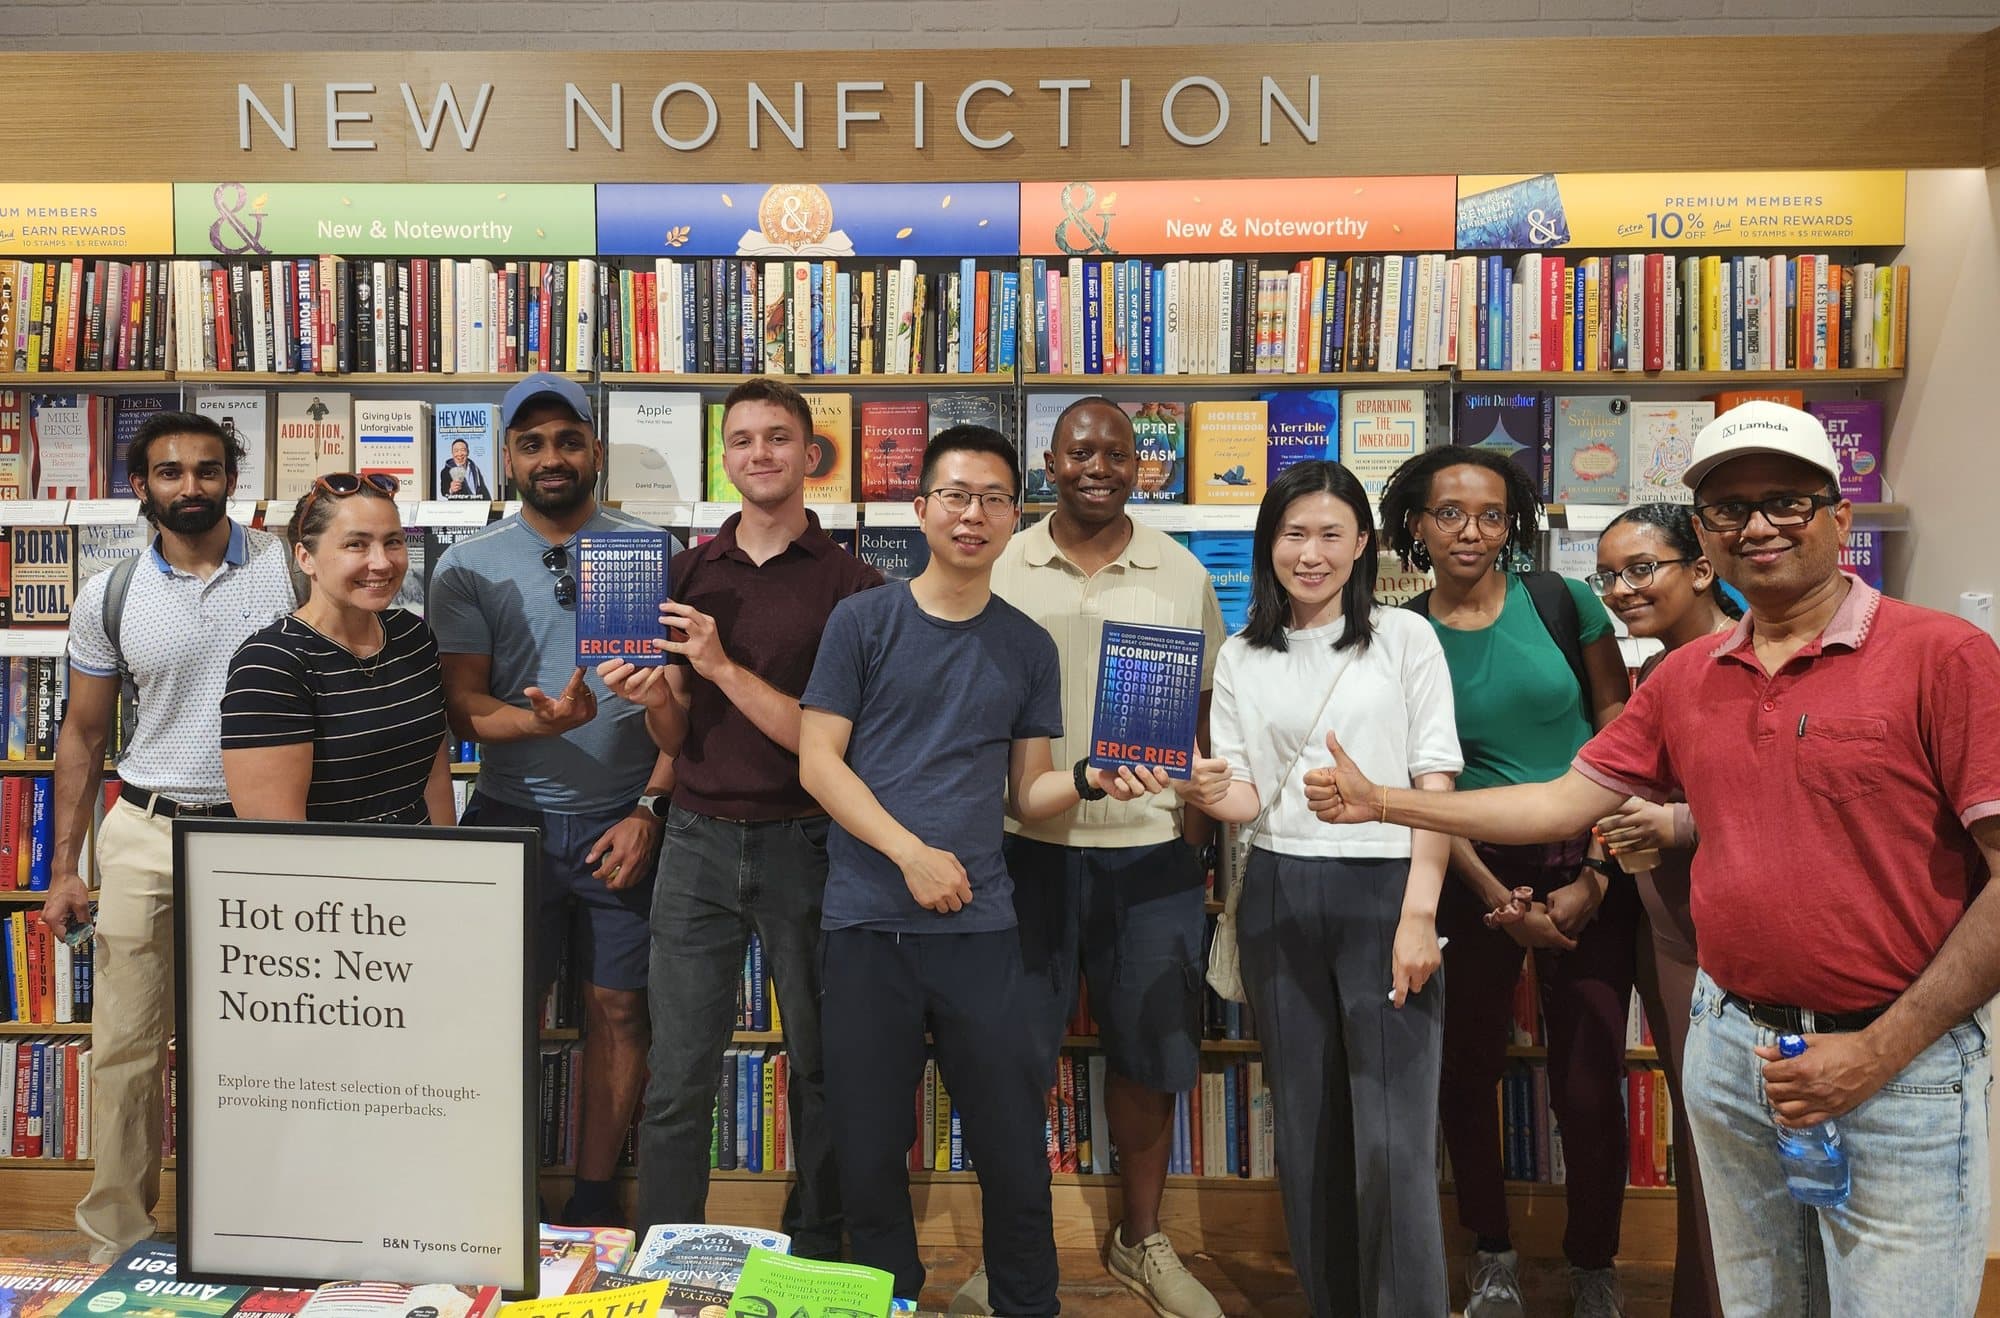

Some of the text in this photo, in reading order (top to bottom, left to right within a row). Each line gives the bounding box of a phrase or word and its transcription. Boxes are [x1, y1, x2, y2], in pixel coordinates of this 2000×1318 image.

[237, 74, 1320, 151] NEW NONFICTION
[1665, 196, 1823, 207] PREMIUM MEMBERS
[27, 208, 97, 217] MEMBERS
[781, 196, 812, 233] &
[1527, 208, 1563, 245] &
[1618, 212, 1704, 240] Extra 10 %
[1740, 215, 1853, 226] EARN REWARDS
[22, 226, 127, 236] EARN REWARDS
[317, 220, 513, 244] New & Noteworthy
[1166, 217, 1368, 241] New & Noteworthy
[1684, 230, 1706, 240] OFF
[232, 266, 244, 292] SCALIA
[299, 270, 311, 344] BLUE POWER
[701, 308, 710, 322] Very
[1131, 310, 1138, 320] OF
[1168, 302, 1178, 333] GODS
[1816, 284, 1829, 350] RESURFACE
[1633, 328, 1641, 350] Point?
[122, 398, 162, 409] The Fix
[1356, 400, 1412, 414] REPARENTING
[1465, 394, 1536, 408] Spirit Daughter
[362, 412, 412, 422] Giving Up Is
[637, 404, 672, 417] Apple
[1207, 412, 1257, 422] HONEST
[47, 412, 80, 423] MIKE
[438, 410, 488, 428] HEY YANG,
[1376, 416, 1392, 430] THE
[1568, 414, 1622, 427] Smallest
[44, 424, 82, 436] PENCE
[282, 424, 345, 441] ADDICTION,
[360, 424, 414, 434] Unforgivable
[865, 424, 922, 436] Firestorm
[1134, 423, 1176, 434] MPIRE
[1201, 423, 1264, 432] MOTHERHOOD
[1270, 422, 1326, 433] A Terrible
[1589, 426, 1616, 439] Joys
[1739, 422, 1789, 433] Lambda
[54, 441, 73, 450] What
[1143, 438, 1156, 447] OF
[1267, 435, 1329, 446] STRENGTH
[1358, 434, 1410, 448] INNER CHILD
[323, 440, 344, 456] Inc.
[866, 478, 921, 486] Jacob Soboroff
[1152, 492, 1176, 500] HUET
[1635, 492, 1666, 502] sarah
[87, 526, 134, 539] We the
[436, 534, 452, 544] THE
[14, 530, 68, 564] BORN
[861, 534, 907, 550] Robert
[81, 544, 140, 560] Women
[581, 550, 663, 561] INCORRUPTIBLE
[581, 561, 663, 571] INCORRUPTIBLE
[861, 554, 908, 570] Wright
[1514, 564, 1530, 572] TO
[581, 572, 662, 582] INCORRUPTIBLE
[14, 584, 70, 619] EQUAL
[1138, 634, 1166, 643] COMPANIES
[580, 640, 662, 654] ERIC RIES
[1106, 644, 1198, 666] INCORRUPTIBLE
[1106, 656, 1196, 678] INCORRUPTIBLE
[1104, 668, 1196, 689] INCORRUPTIBLE
[38, 670, 50, 739] Five Bullets
[1096, 740, 1141, 760] ERIC
[1144, 745, 1188, 766] RIES
[218, 898, 407, 937] Hot off the
[220, 944, 414, 984] Press: New
[218, 990, 407, 1030] Nonfiction
[218, 1074, 481, 1103] Explore the latest selection of thought-
[218, 1094, 447, 1118] provoking nonfiction paperbacks.
[382, 1238, 502, 1256] B&N Tysons Corner
[702, 1237, 730, 1246] ISSA
[690, 1244, 734, 1254] ISLAM
[760, 1278, 783, 1289] Years
[770, 1272, 814, 1284] Evolution
[134, 1277, 227, 1302] Annie
[786, 1284, 819, 1294] Million
[816, 1280, 852, 1290] Human
[676, 1290, 728, 1305] KOSTYA
[764, 1288, 786, 1298] Body
[791, 1294, 820, 1302] Female
[844, 1290, 870, 1300] Drove
[840, 1297, 862, 1306] How
